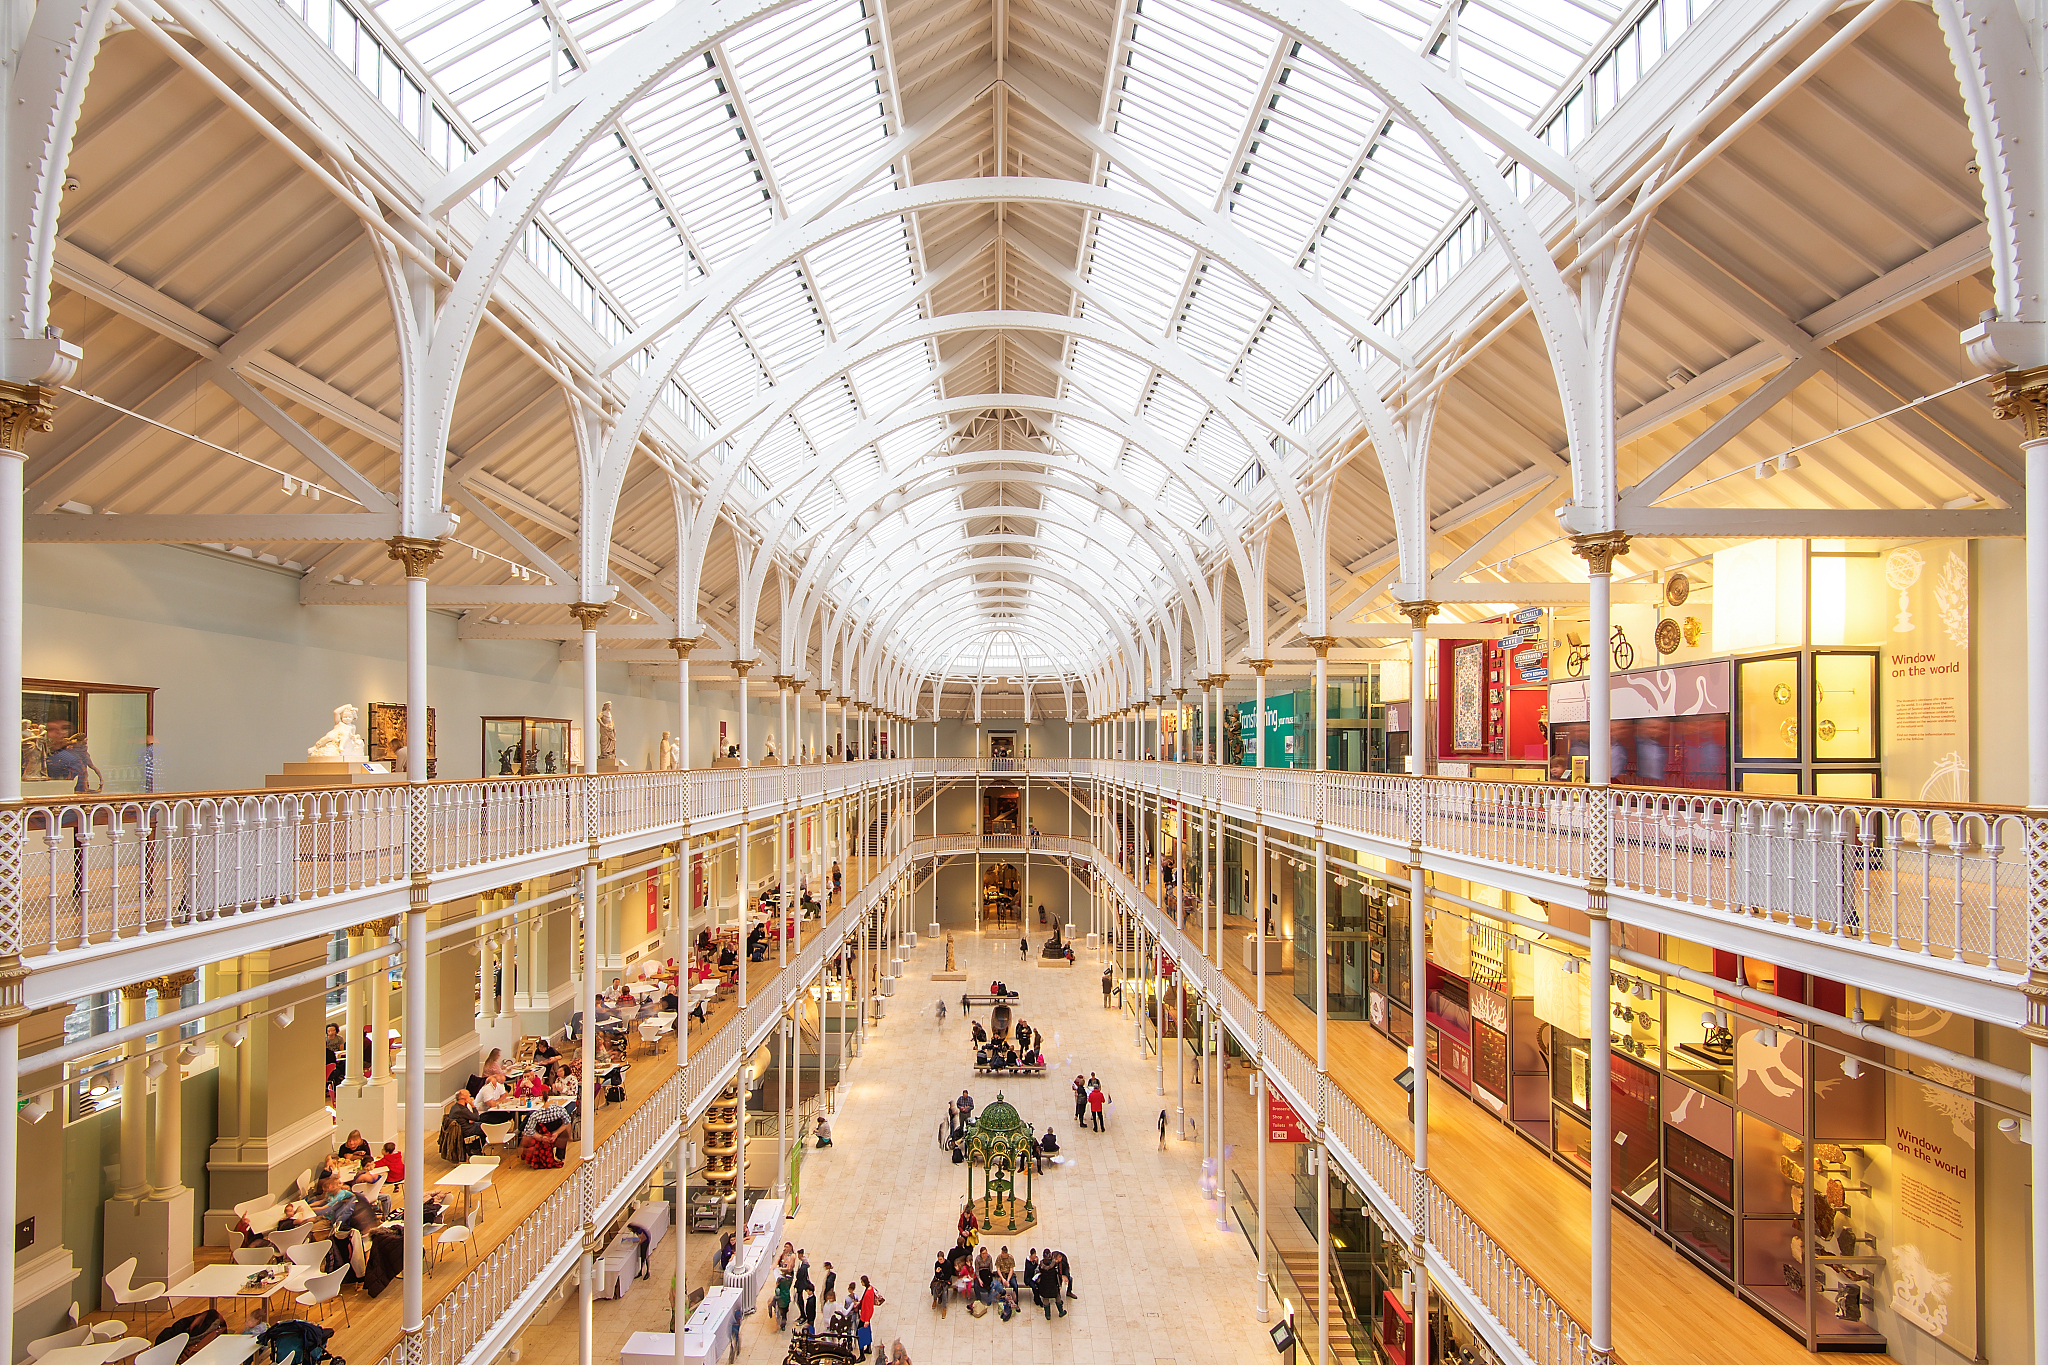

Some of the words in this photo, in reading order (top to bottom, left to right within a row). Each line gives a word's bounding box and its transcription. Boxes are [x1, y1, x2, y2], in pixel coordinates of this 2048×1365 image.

[1892, 652, 1936, 665] Window
[1892, 668, 1905, 678] on
[1909, 666, 1925, 676] the
[1930, 662, 1959, 674] world
[1897, 1127, 1942, 1155] Window
[1897, 1142, 1910, 1154] on
[1914, 1148, 1931, 1163] the
[1934, 1158, 1966, 1179] world
